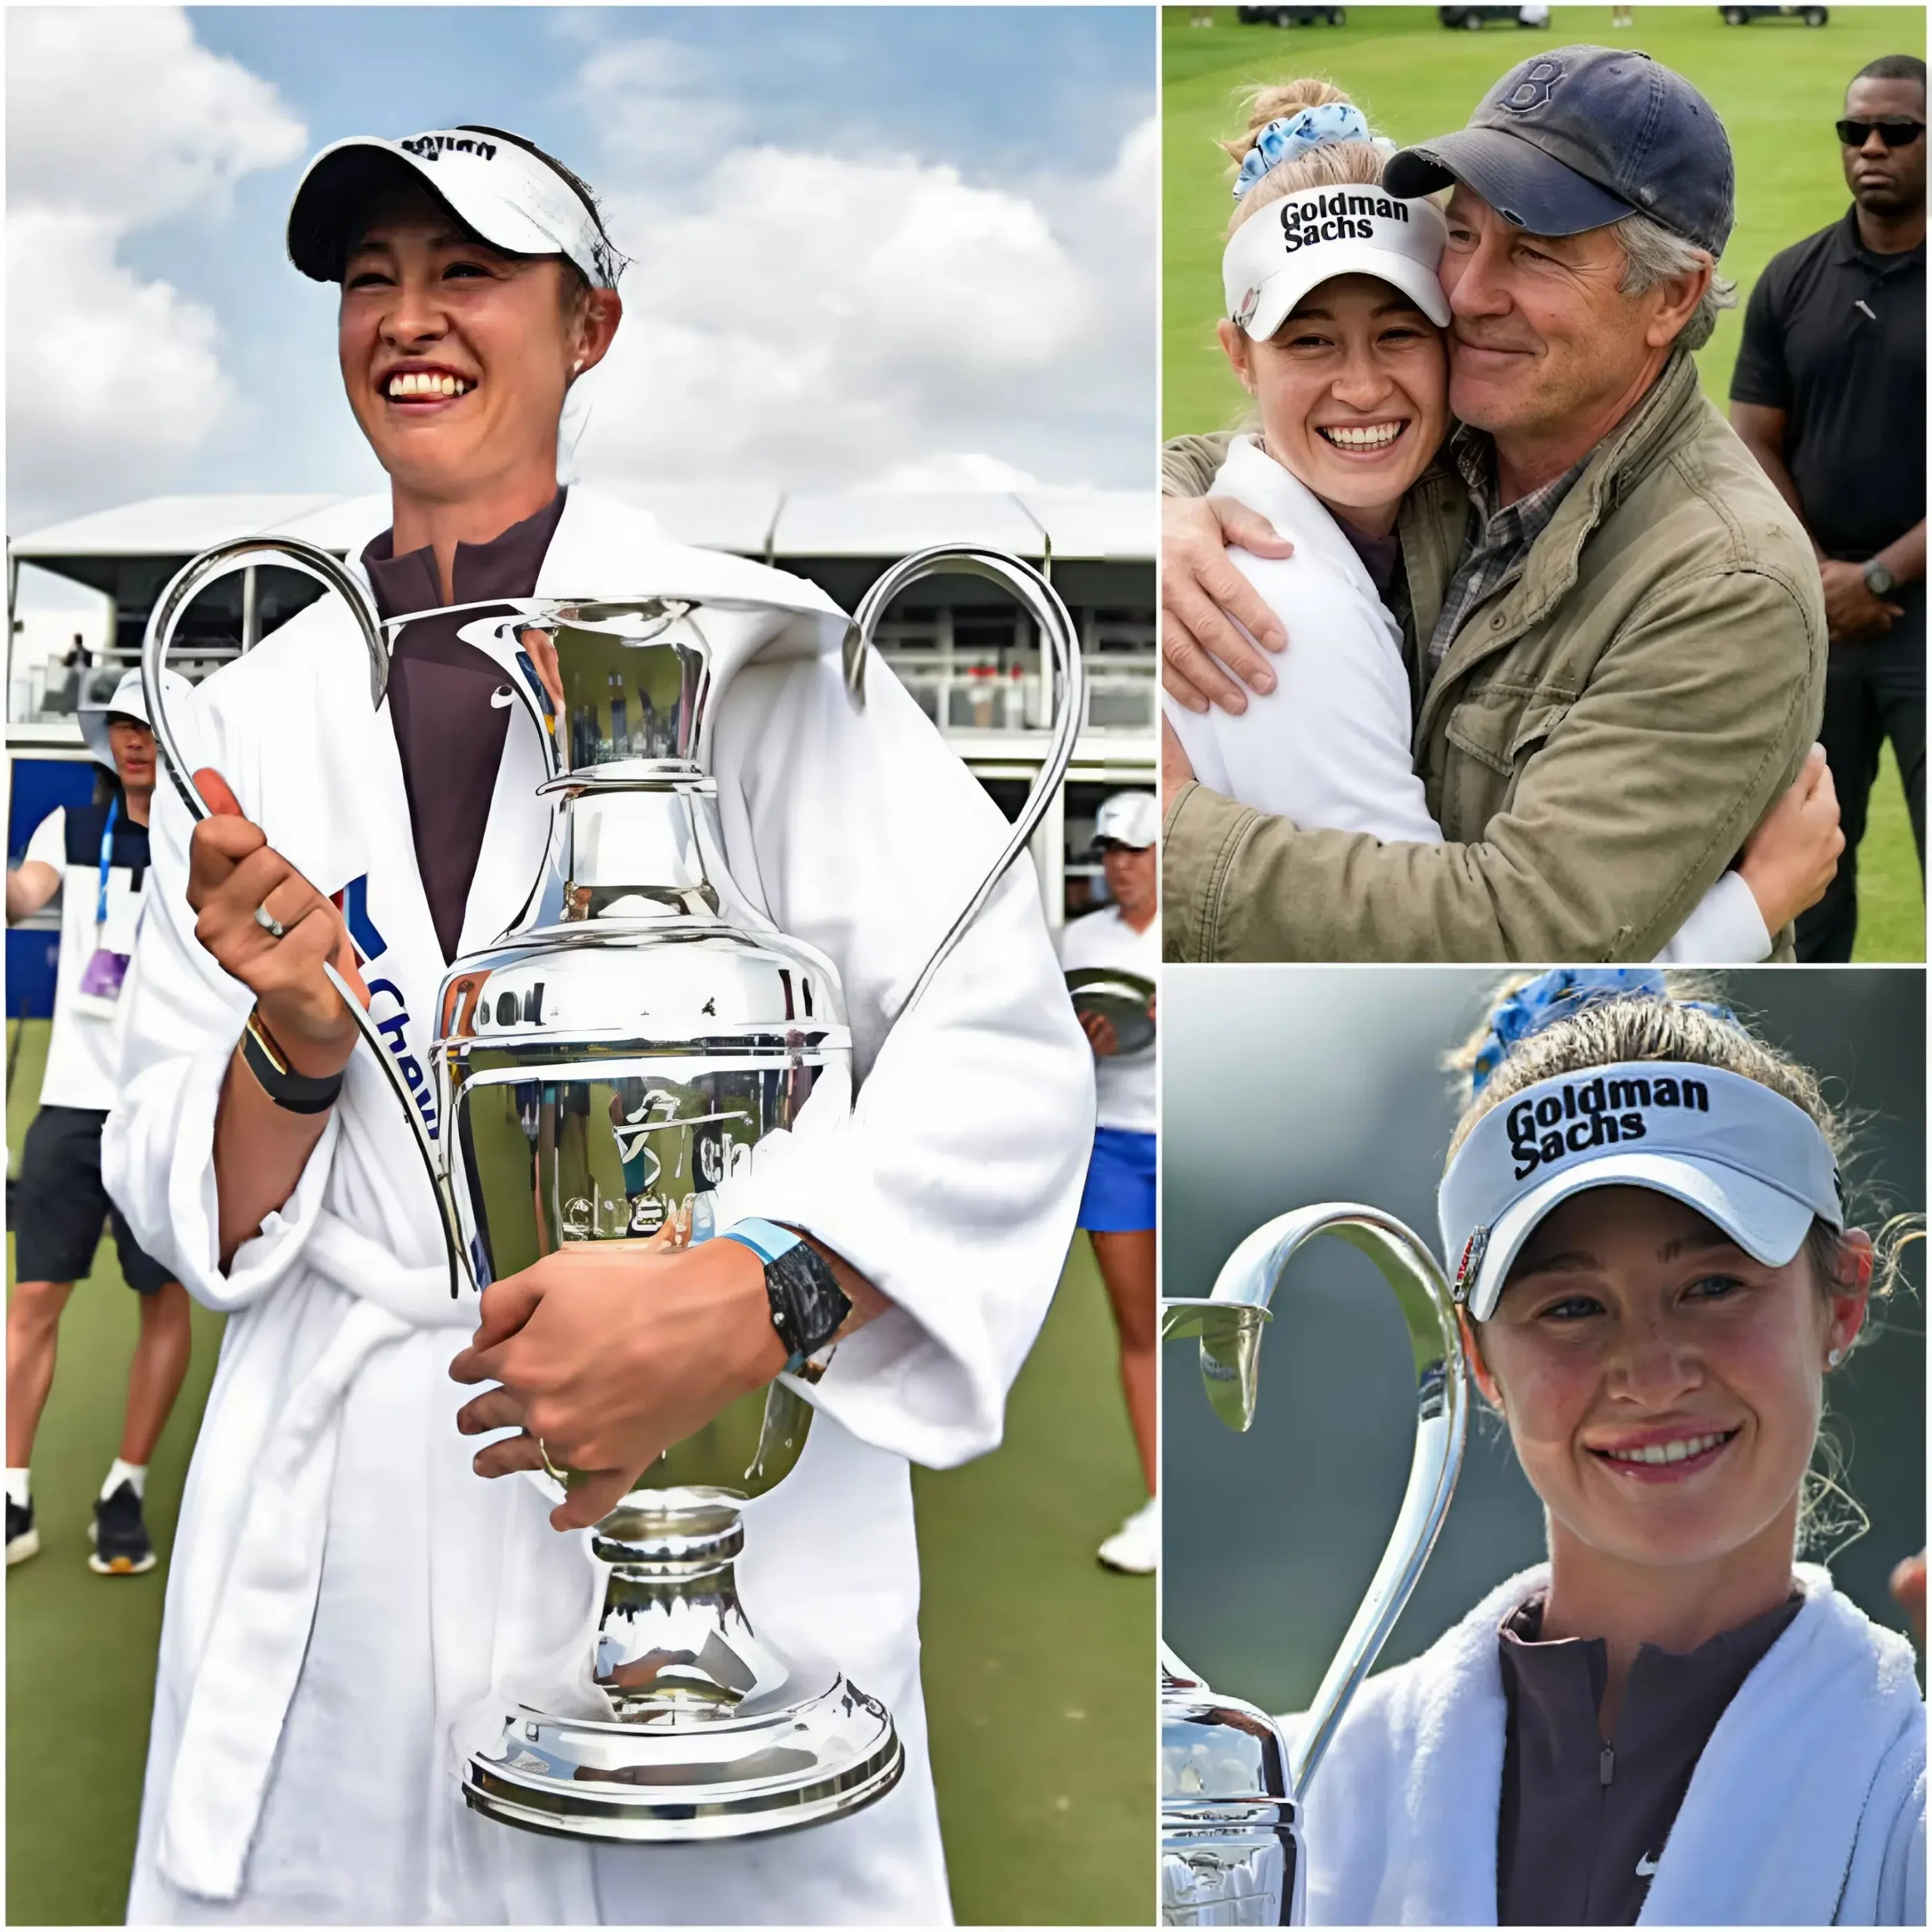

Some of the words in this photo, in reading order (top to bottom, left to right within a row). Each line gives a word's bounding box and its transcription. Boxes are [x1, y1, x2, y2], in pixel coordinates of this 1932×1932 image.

[1497, 58, 1567, 113] B
[1281, 192, 1408, 231] Goldman
[1284, 217, 1374, 253] Sachs
[1506, 1078, 1709, 1143] Goldman
[1511, 1112, 1647, 1180] Sachs
